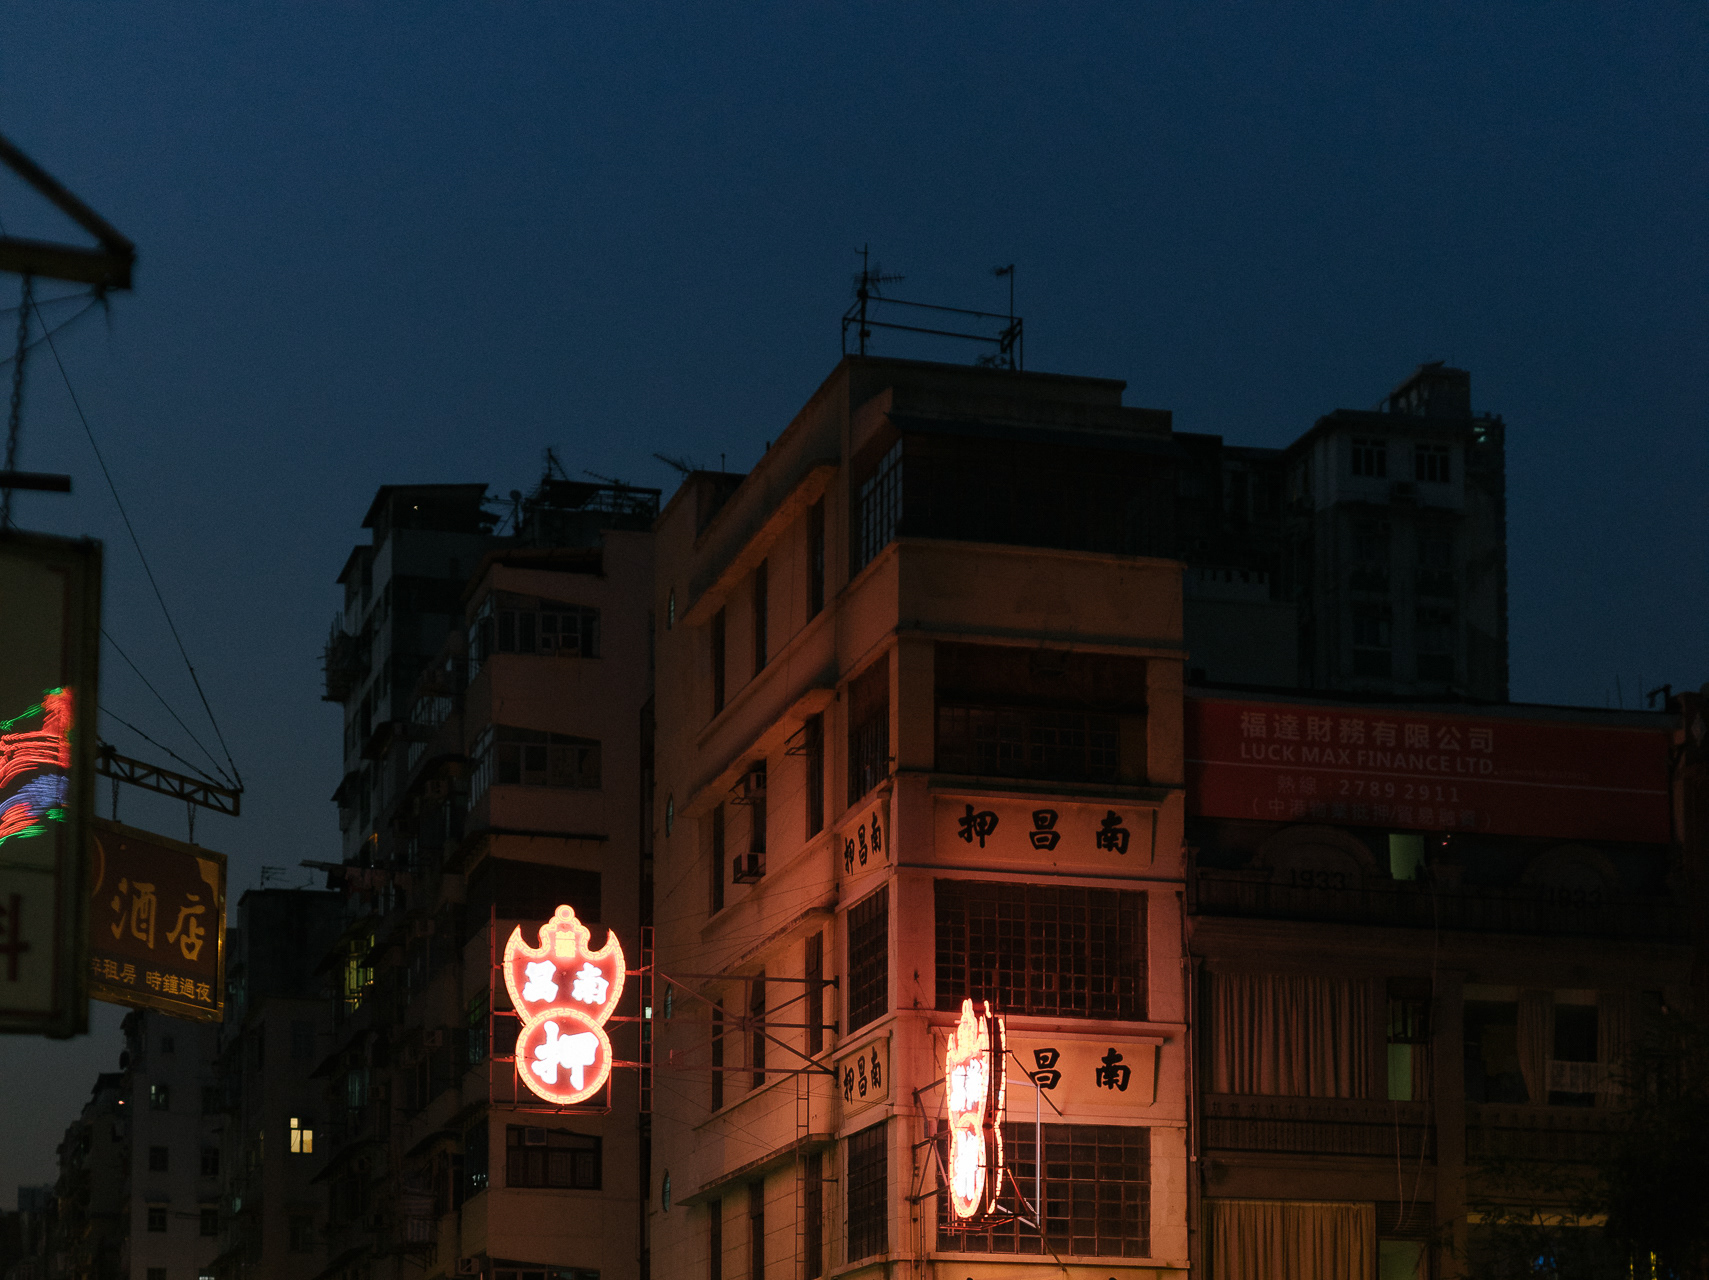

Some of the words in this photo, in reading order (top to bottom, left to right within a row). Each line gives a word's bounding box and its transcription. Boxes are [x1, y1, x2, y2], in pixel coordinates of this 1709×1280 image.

[1238, 711, 1493, 754] 福達財務有限公司
[1239, 743, 1294, 762] LUCK
[1300, 746, 1350, 766] MAX
[1356, 750, 1449, 773] FINANCE
[1455, 757, 1498, 776] LTD.
[1339, 779, 1395, 798] 2789
[1404, 784, 1459, 803] 2911
[1290, 868, 1345, 891] 1933
[111, 877, 207, 961] 酒店
[145, 971, 212, 1003] 時鐘過夜
